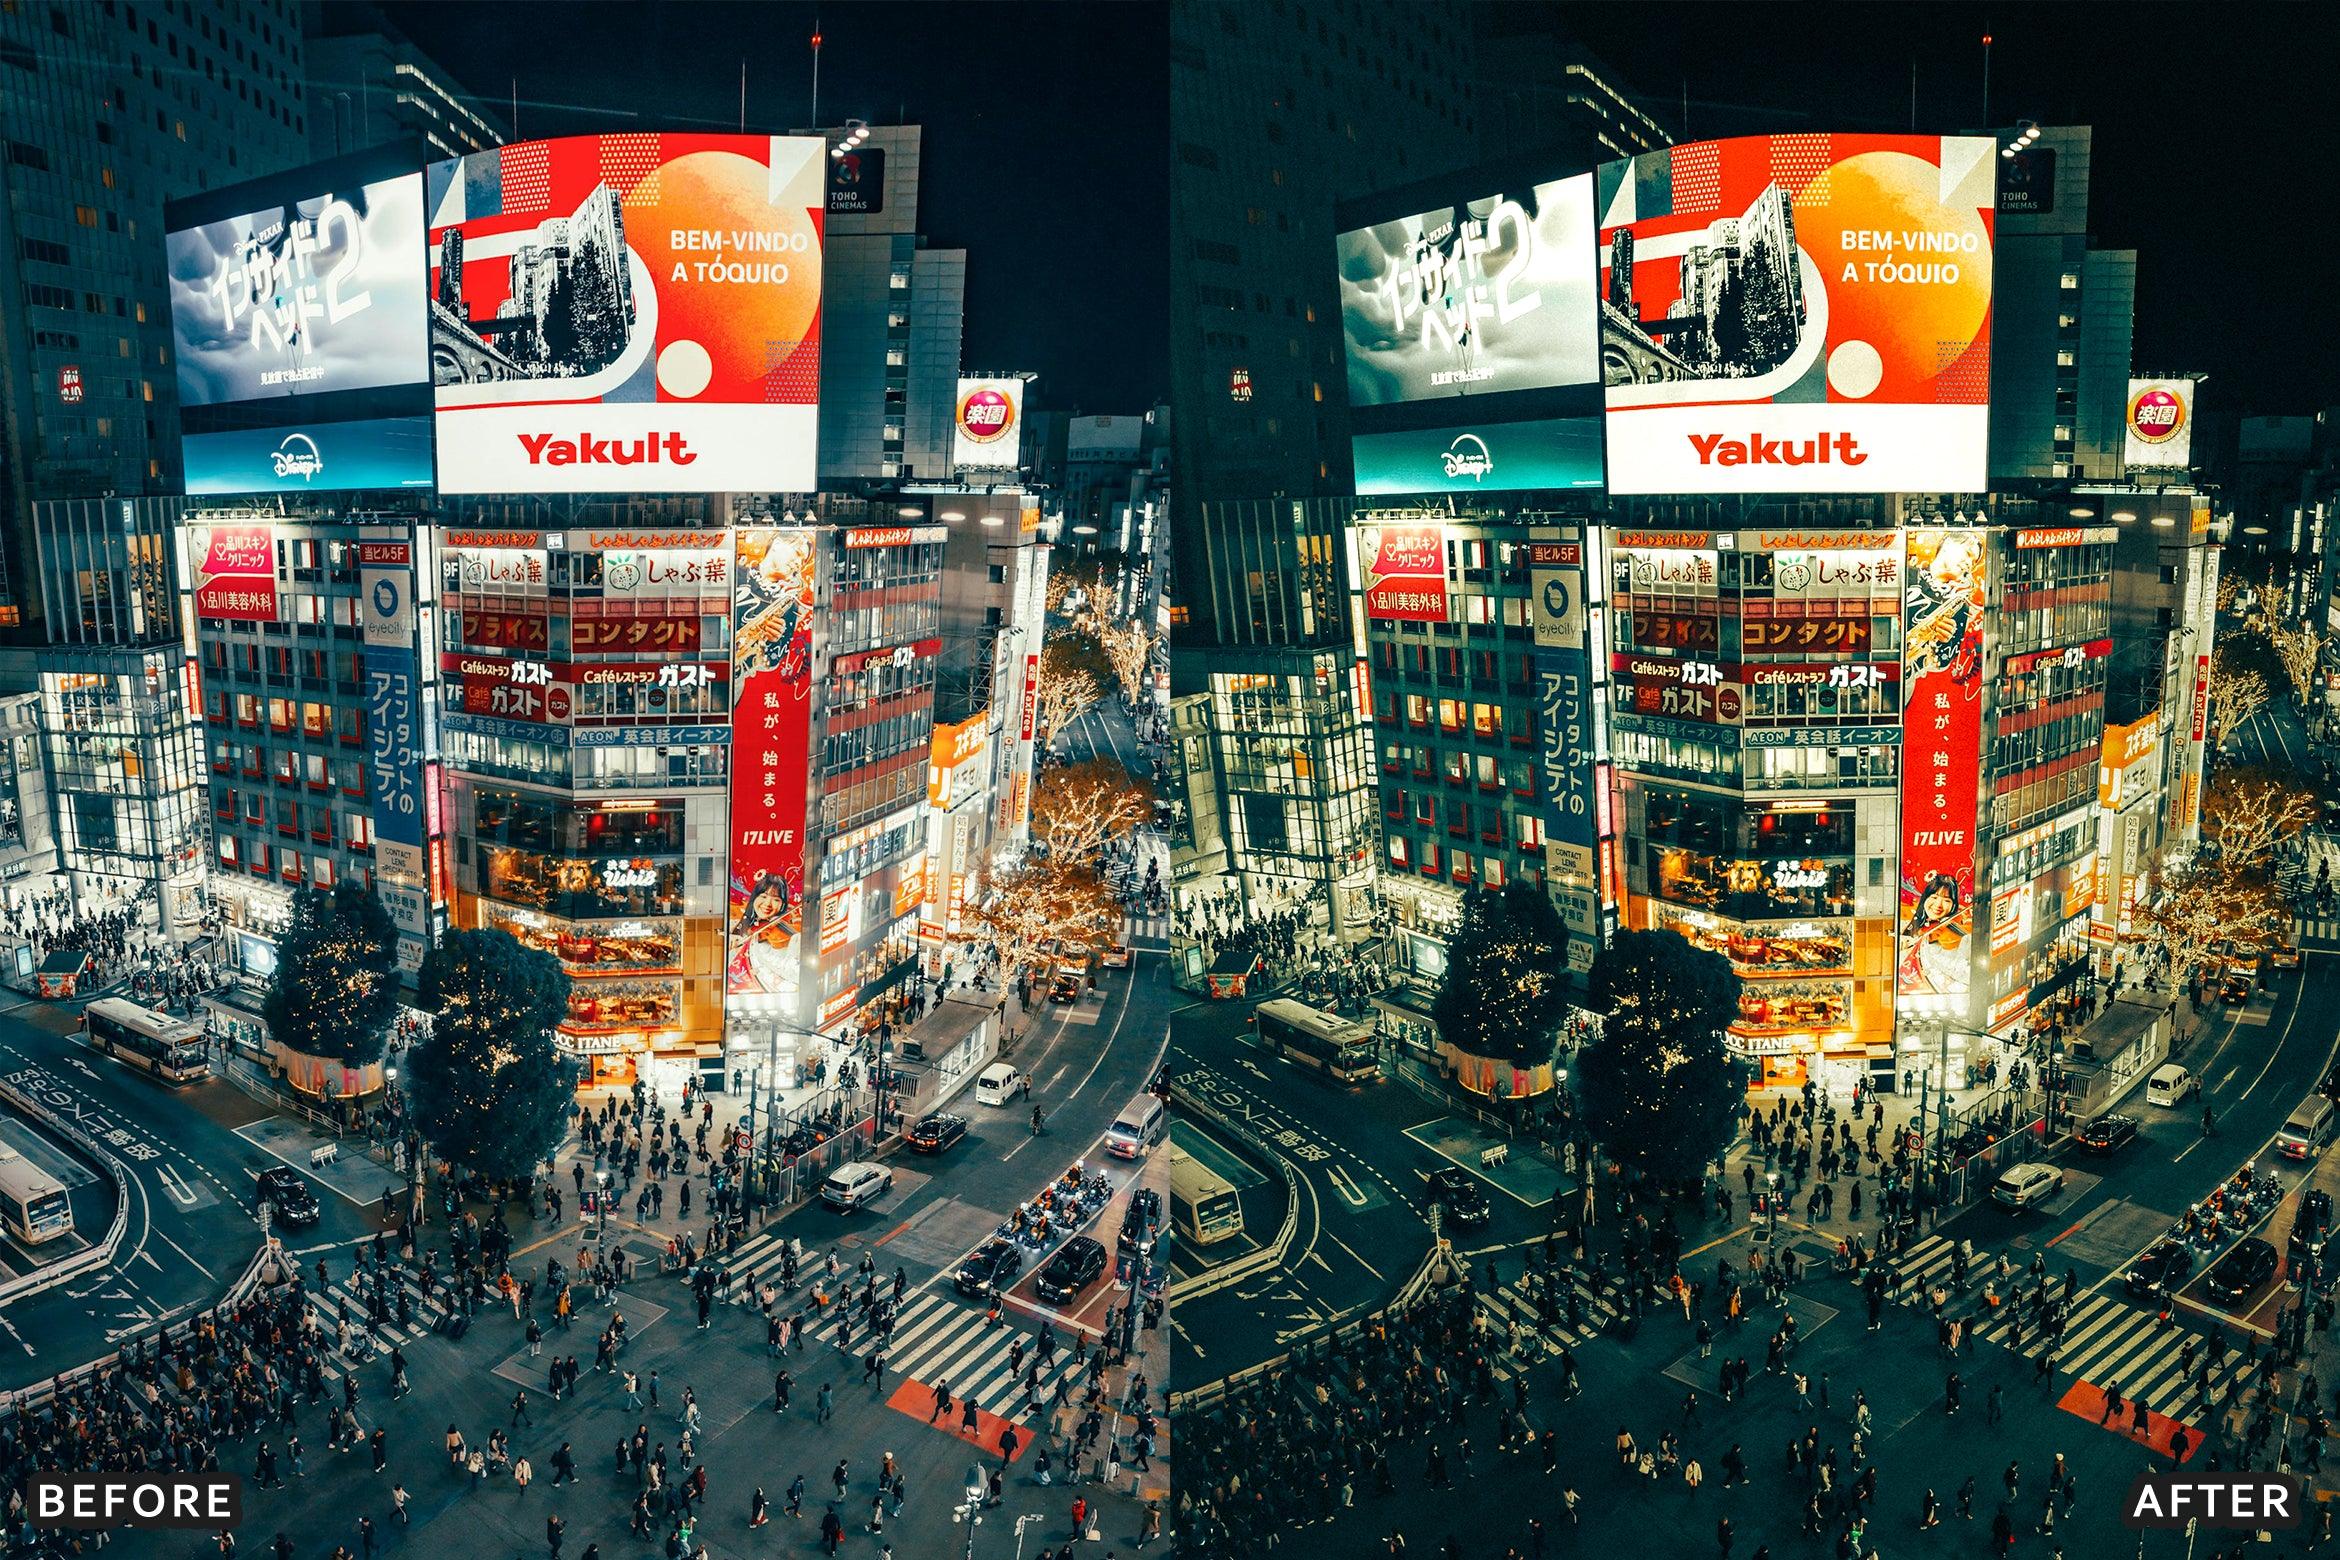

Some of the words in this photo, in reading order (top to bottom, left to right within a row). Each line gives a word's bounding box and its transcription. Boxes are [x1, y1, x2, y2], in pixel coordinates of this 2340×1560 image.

[830, 201, 868, 210] CINEMAS
[831, 191, 858, 201] TOHO
[2000, 201, 2039, 210] CINEMAS
[2001, 191, 2029, 201] TOHO
[258, 221, 284, 241] PIXAR
[670, 229, 809, 251] BEM-VINDO
[1428, 221, 1455, 241] PIXAR
[1840, 229, 1980, 251] BEM-VINDO
[317, 200, 372, 325] 2
[671, 263, 688, 282] A
[694, 254, 789, 284] TÓQUIO
[1487, 200, 1543, 325] 2
[1841, 263, 1859, 282] A
[1864, 254, 1960, 284] TÓQUIO
[212, 219, 317, 331] インサイド
[1382, 219, 1488, 331] インサイド
[251, 285, 324, 354] ヘッド
[1421, 285, 1495, 354] ヘッド
[966, 404, 1008, 425] 楽園
[2136, 404, 2179, 425] 楽園
[516, 433, 698, 465] Yakult
[1686, 433, 1869, 465] Yakult
[270, 451, 323, 482] Disney+
[225, 535, 269, 551] 品川スキン
[446, 531, 539, 547] しゃぶしゃぶバイキング
[590, 532, 726, 549] しゃぶしゃぶバイキング
[1395, 535, 1440, 551] 品川スキン
[1616, 531, 1710, 547] しゃぶしゃぶバイキング
[1760, 532, 1897, 549] しゃぶしゃぶバイキング
[228, 551, 265, 568] クリニック
[364, 546, 405, 561] 当ビル5F
[1398, 551, 1436, 568] クリニック
[1534, 546, 1576, 561] 当ビル5F
[2206, 551, 2217, 571] BIC
[442, 562, 459, 578] 9F
[489, 557, 543, 584] しゃぶ葉
[648, 556, 728, 584] しゃぶ葉
[1612, 562, 1630, 578] 9F
[1659, 557, 1714, 584] しゃぶ葉
[1818, 556, 1899, 584] しゃぶ葉
[207, 590, 273, 613] 品川美容外科
[1377, 590, 1444, 613] 品川美容外科
[2202, 573, 2216, 622] CAMERA
[368, 622, 407, 637] eyecity
[573, 620, 696, 646] コンタクト
[1538, 622, 1578, 637] eyecity
[1743, 620, 1867, 646] コンタクト
[511, 661, 553, 686] ガスト
[658, 665, 717, 687] ガスト
[1681, 661, 1724, 686] ガスト
[1828, 665, 1888, 687] ガスト
[446, 684, 464, 700] 7F
[468, 685, 490, 700] Café
[491, 686, 542, 717] ガスト
[1616, 684, 1635, 700] 7F
[1638, 685, 1661, 700] Café
[1661, 686, 1713, 717] ガスト
[550, 700, 570, 712] ガスト
[1022, 688, 1036, 733] TaxFree
[1720, 700, 1741, 712] ガスト
[2192, 688, 2207, 733] TaxFree
[445, 715, 469, 730] AEON
[475, 717, 548, 741] 英会話イーオン
[578, 730, 616, 744] AEON
[623, 728, 729, 745] 英会話イーオン
[1615, 715, 1640, 730] AEON
[1645, 717, 1719, 741] 英会話イーオン
[1748, 730, 1787, 744] AEON
[1793, 728, 1900, 745] 英会話イーオン
[371, 671, 397, 811] アイシティ
[394, 674, 414, 815] コンタクトの
[1541, 671, 1568, 811] アイシティ
[1564, 674, 1585, 815] コンタクトの
[762, 691, 781, 820] 私が、始まる。
[1932, 691, 1952, 820] 私が、始まる。
[742, 830, 794, 846] 17LIVE
[1912, 830, 1965, 846] 17LIVE
[384, 847, 412, 860] CONTACT
[391, 858, 406, 868] LENS
[1554, 847, 1583, 860] CONTACT
[1561, 858, 1577, 868] LENS
[821, 848, 857, 882] AGA
[1991, 848, 2028, 882] AGA
[888, 912, 917, 942] LUSH
[2058, 912, 2088, 942] LUSH
